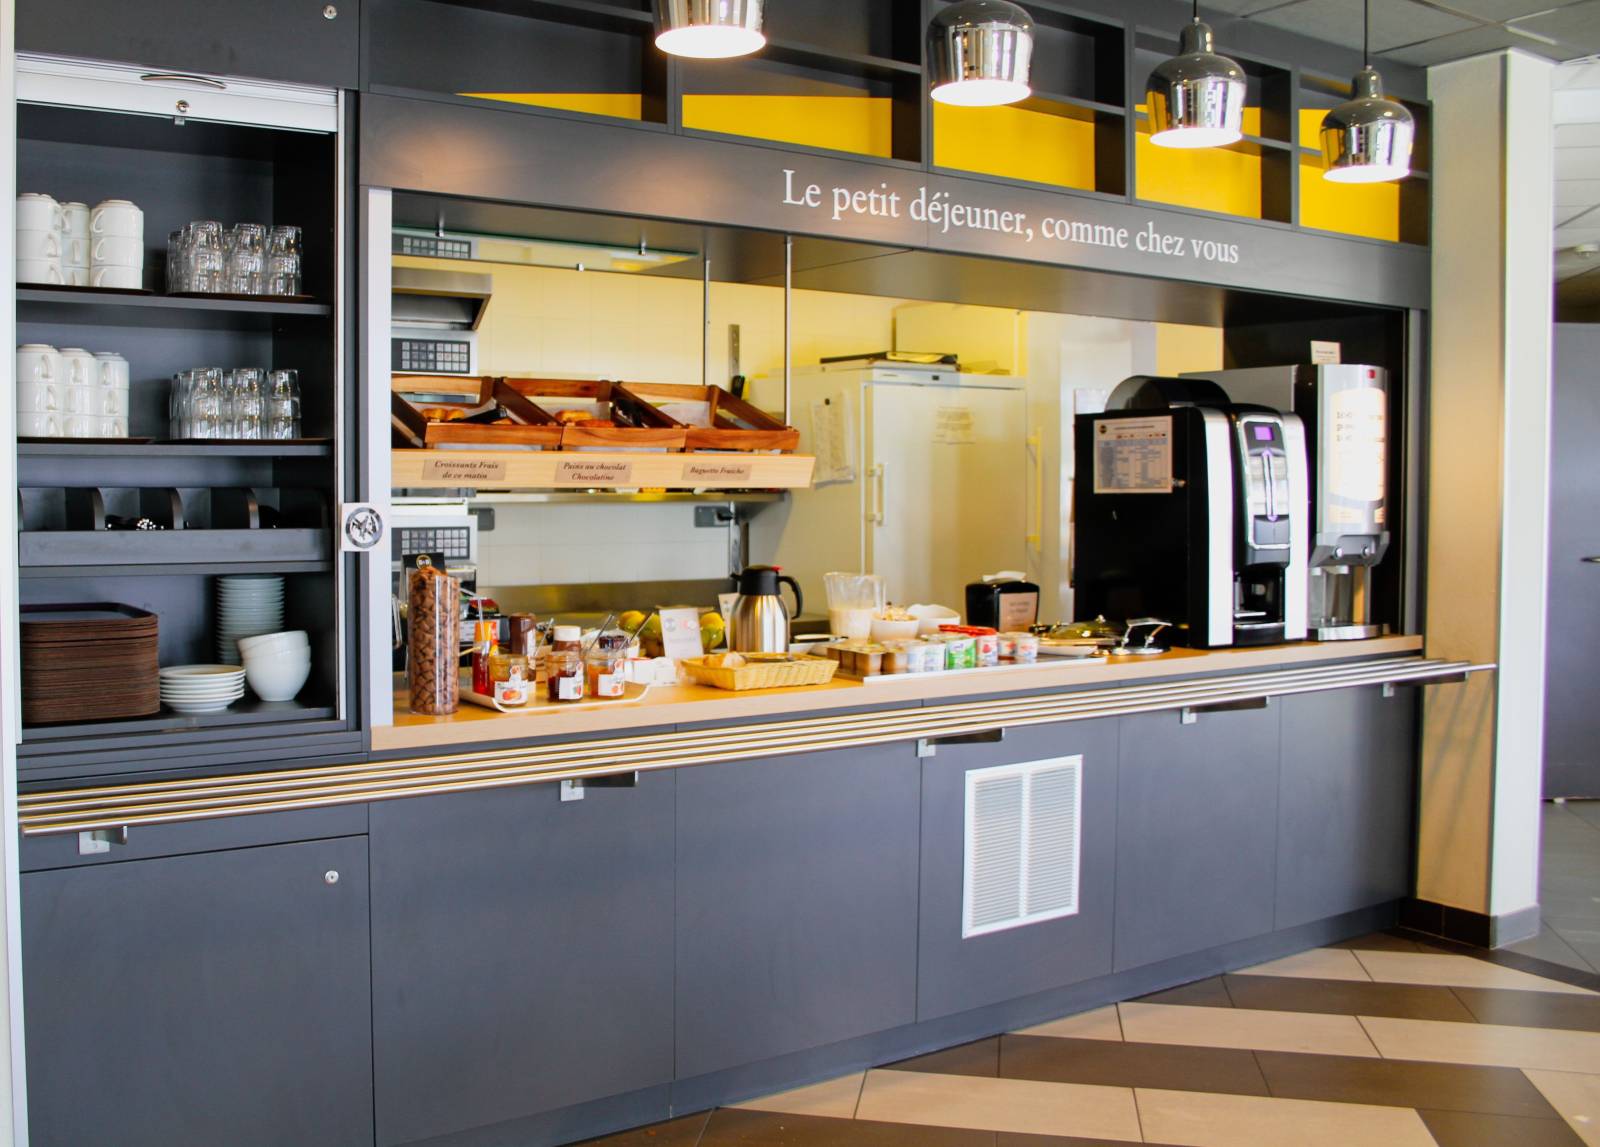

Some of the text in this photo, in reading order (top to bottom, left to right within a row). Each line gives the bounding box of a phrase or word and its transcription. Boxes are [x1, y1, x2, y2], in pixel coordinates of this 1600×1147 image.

[782, 169, 1239, 264] Le petit déjeuner, comme chez vous
[596, 463, 626, 471] chocolat
